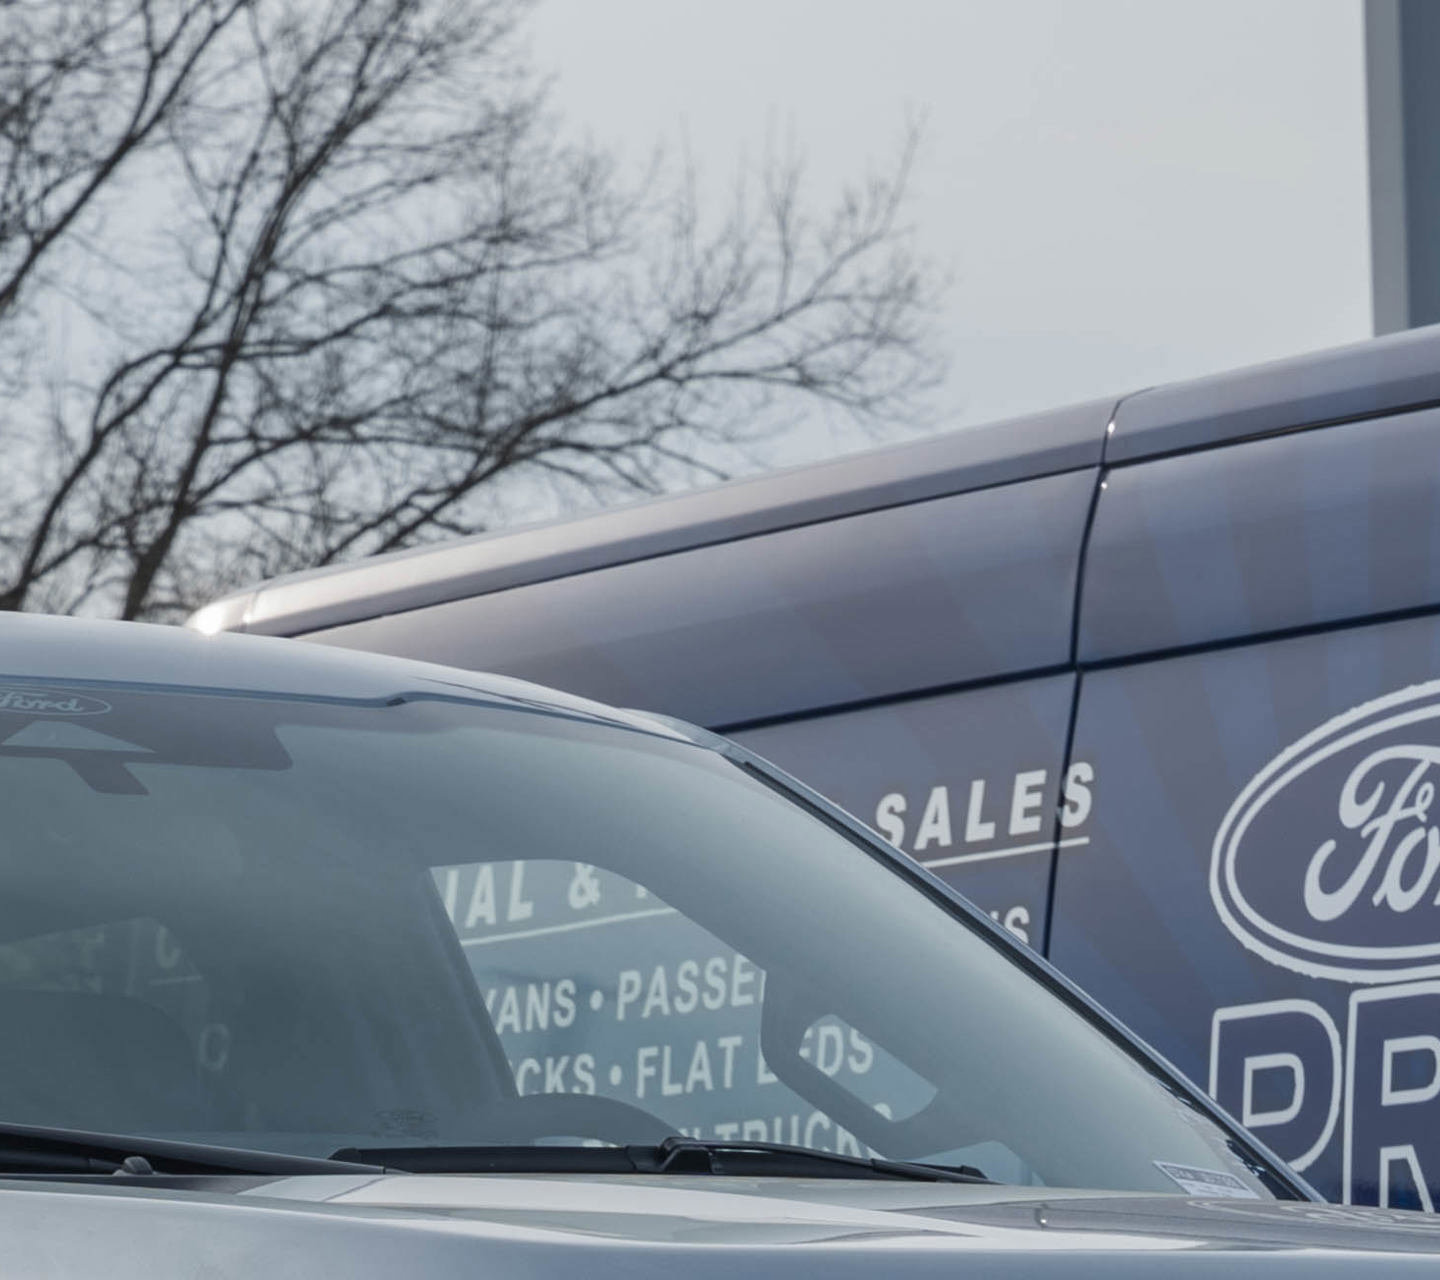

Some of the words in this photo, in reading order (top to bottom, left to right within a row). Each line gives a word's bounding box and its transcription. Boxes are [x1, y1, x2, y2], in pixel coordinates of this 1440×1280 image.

[875, 762, 1094, 851] SALES
[616, 952, 767, 1021] PASSE
[636, 1036, 743, 1098] FLAT
